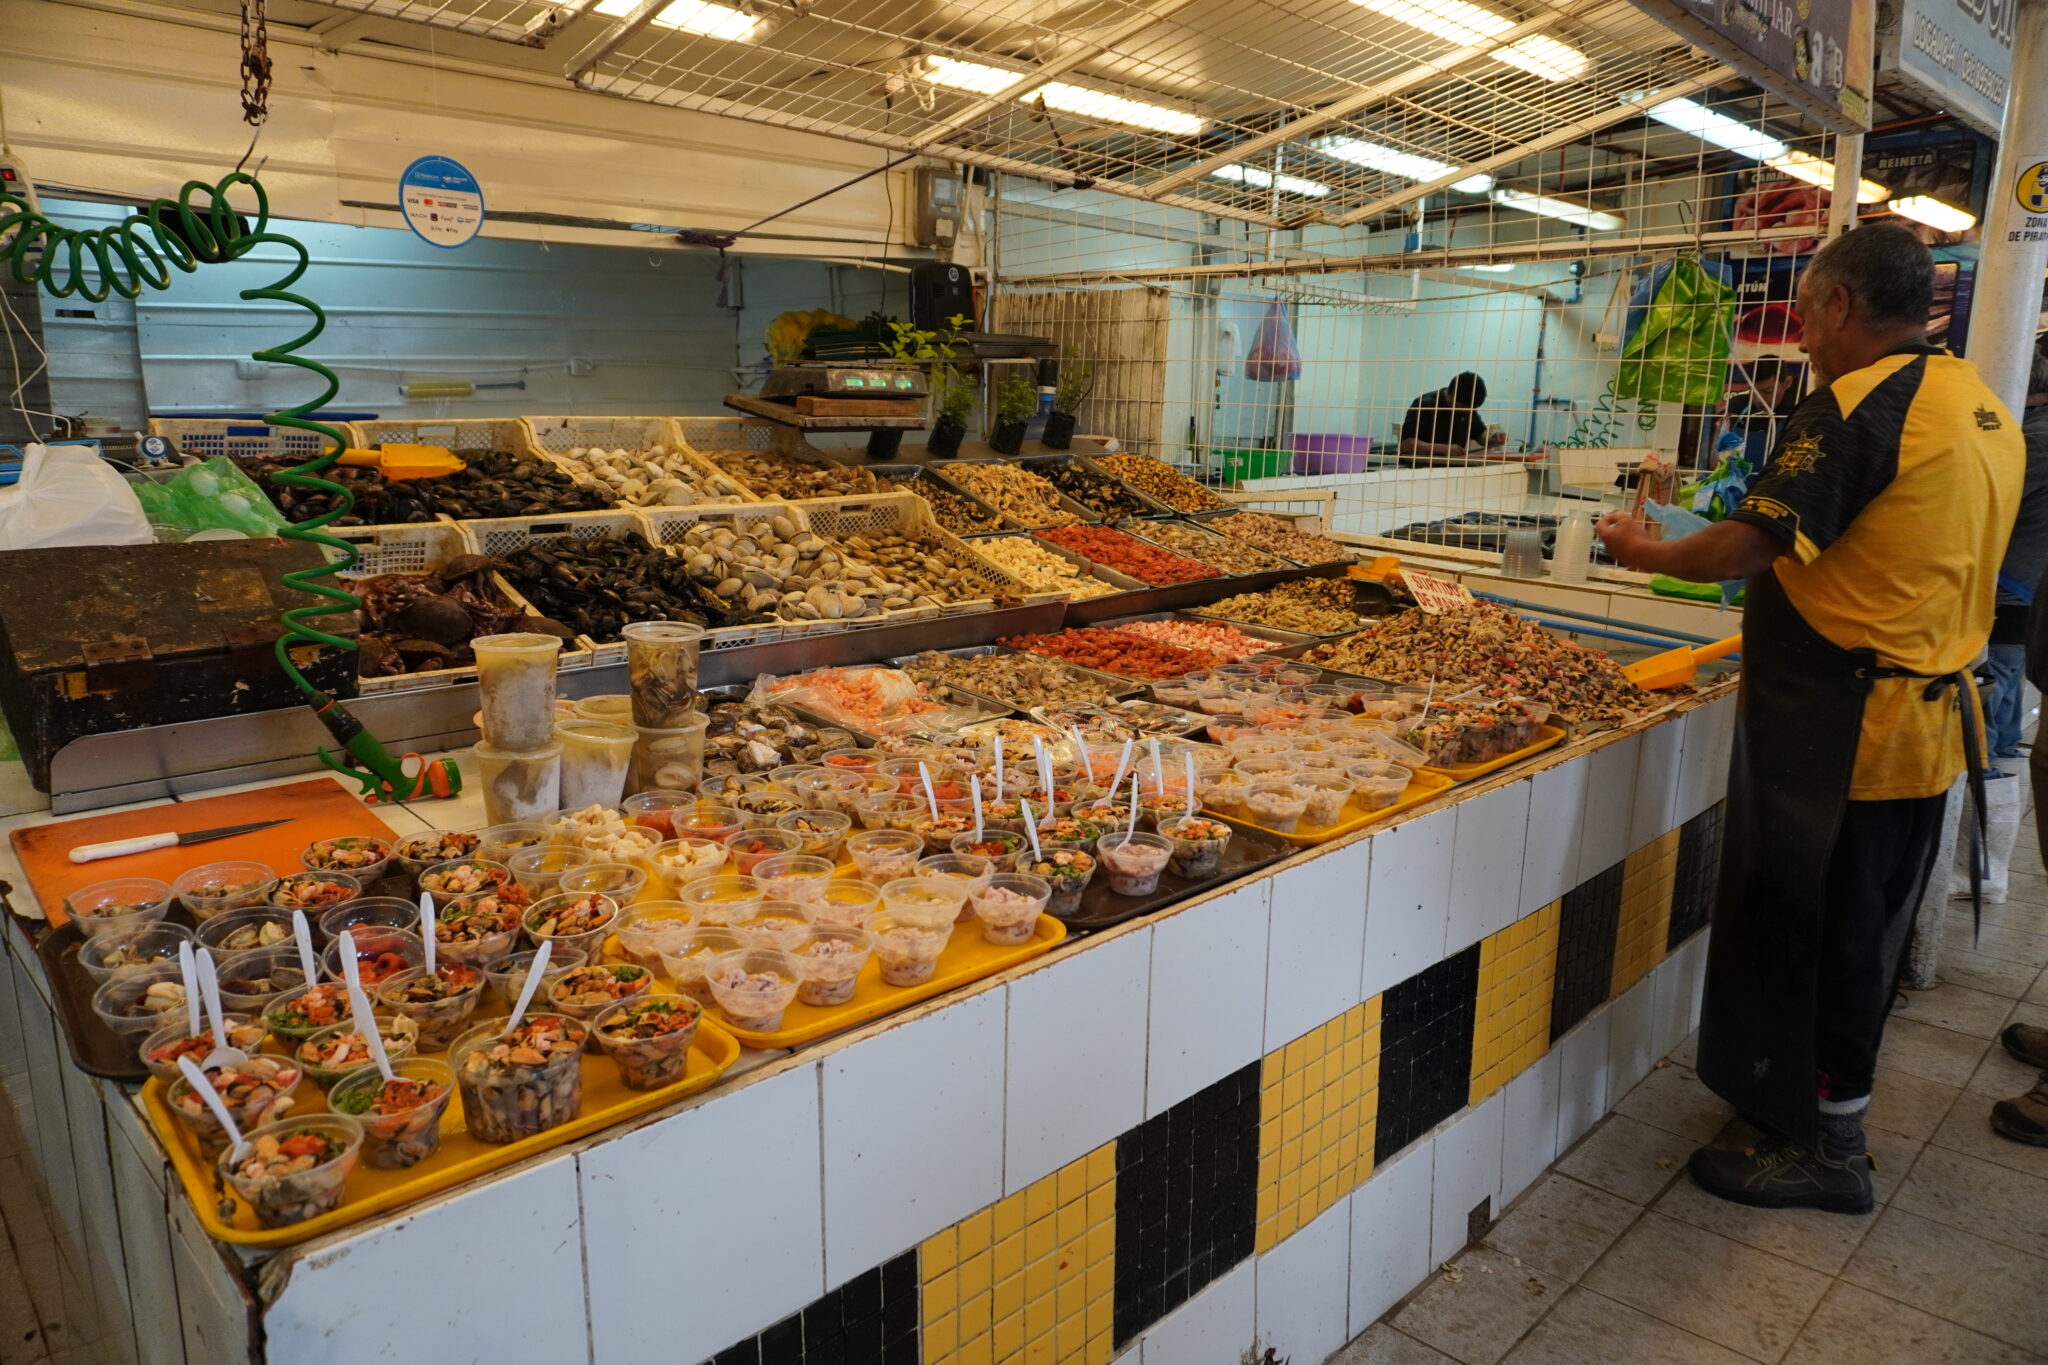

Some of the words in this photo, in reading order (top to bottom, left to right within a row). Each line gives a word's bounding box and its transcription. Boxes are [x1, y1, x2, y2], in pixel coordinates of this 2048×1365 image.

[1913, 11, 1942, 64] LOCAL
[1878, 153, 1933, 170] REINETA
[2025, 216, 2048, 228] ZONA
[2008, 231, 2021, 242] DE
[2023, 231, 2048, 242] PIRAT
[1737, 279, 1768, 293] ATÚN
[1410, 574, 1461, 598] SURTIDO
[1413, 590, 1435, 608] DE
